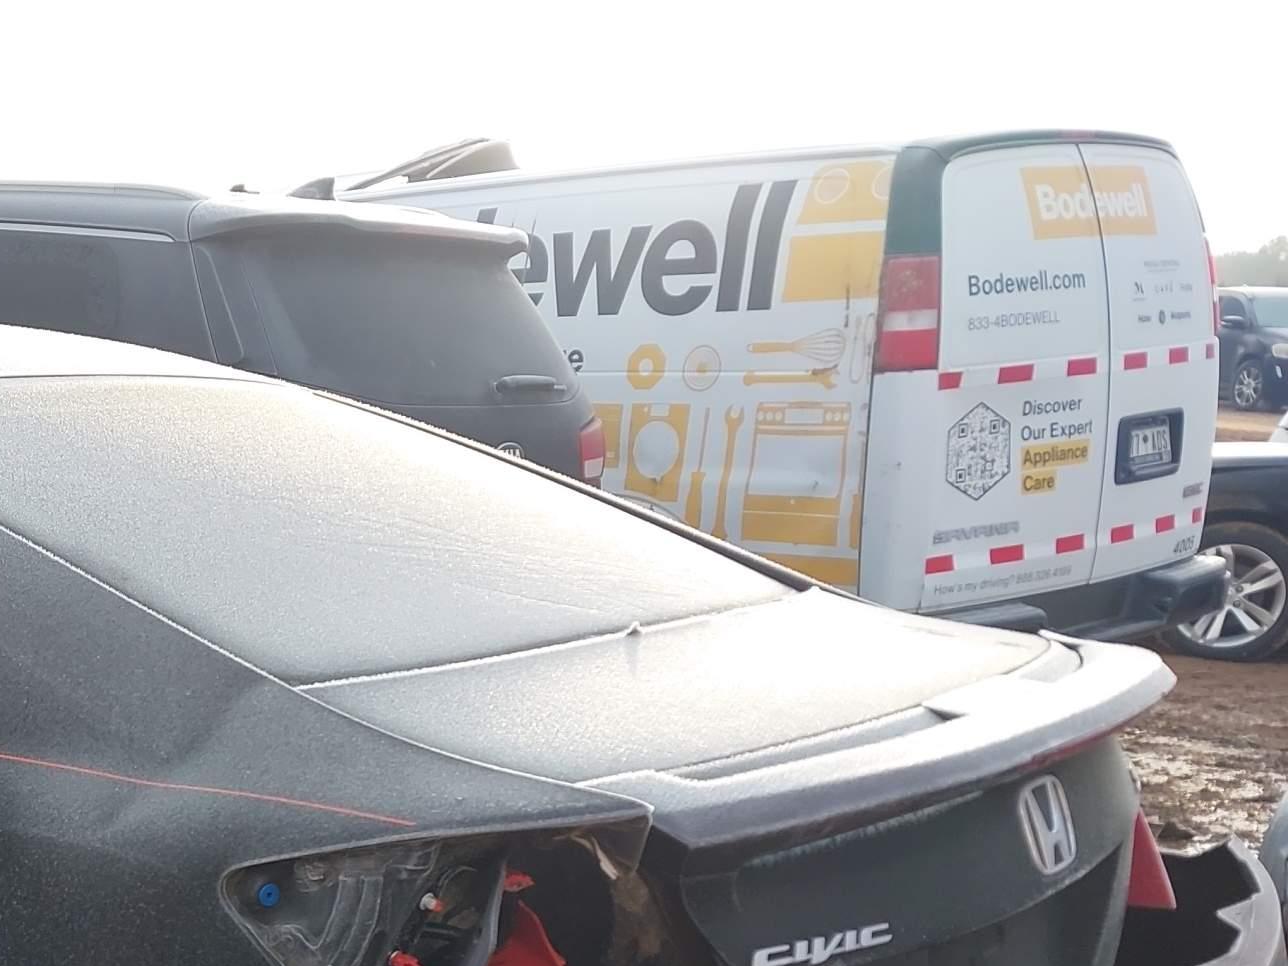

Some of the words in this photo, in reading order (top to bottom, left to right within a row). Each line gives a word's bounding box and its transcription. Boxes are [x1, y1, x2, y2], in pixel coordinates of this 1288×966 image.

[1035, 184, 1147, 220] Bodewell
[477, 180, 799, 317] ewell
[968, 270, 1086, 297] Bodewell.com
[968, 311, 1061, 331] 833-4BODEWELL
[1022, 398, 1083, 416] Discover
[1021, 424, 1046, 441] Our
[1050, 420, 1093, 439] Expert
[1023, 445, 1088, 466] Appliance
[1023, 475, 1055, 492] Care
